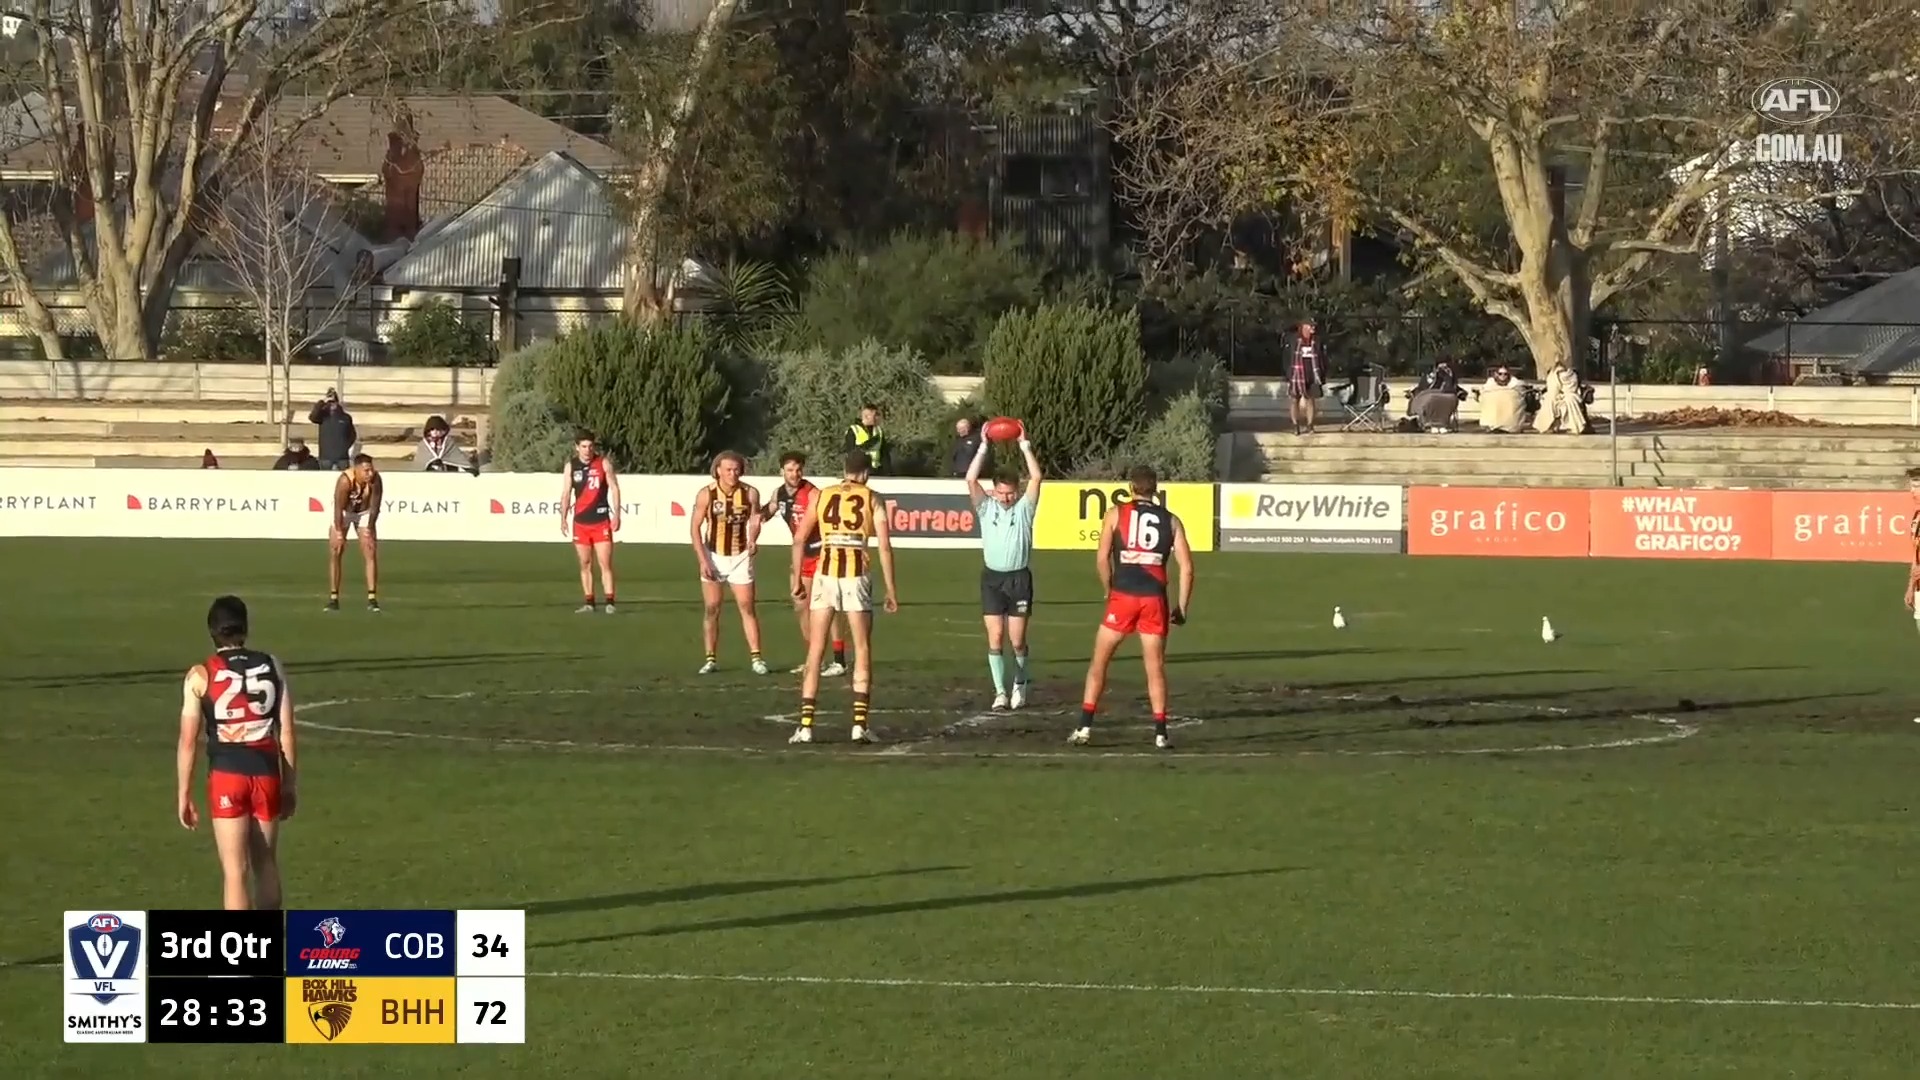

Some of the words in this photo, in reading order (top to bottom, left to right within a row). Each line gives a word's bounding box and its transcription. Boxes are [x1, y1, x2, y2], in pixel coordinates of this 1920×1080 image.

[0, 496, 97, 510] RYPLANT
[148, 497, 279, 512] BARRYPLANT
[384, 500, 460, 514] YPLANT
[1622, 497, 1697, 513] #WHAT
[822, 493, 866, 532] 43
[1430, 501, 1566, 537] grafico
[1127, 509, 1160, 550] 16
[1635, 515, 1684, 532] WILL
[1689, 515, 1733, 532] YOU
[1794, 505, 1906, 542] grafic
[1635, 534, 1742, 551] GRAFICO?
[214, 663, 276, 720] 25
